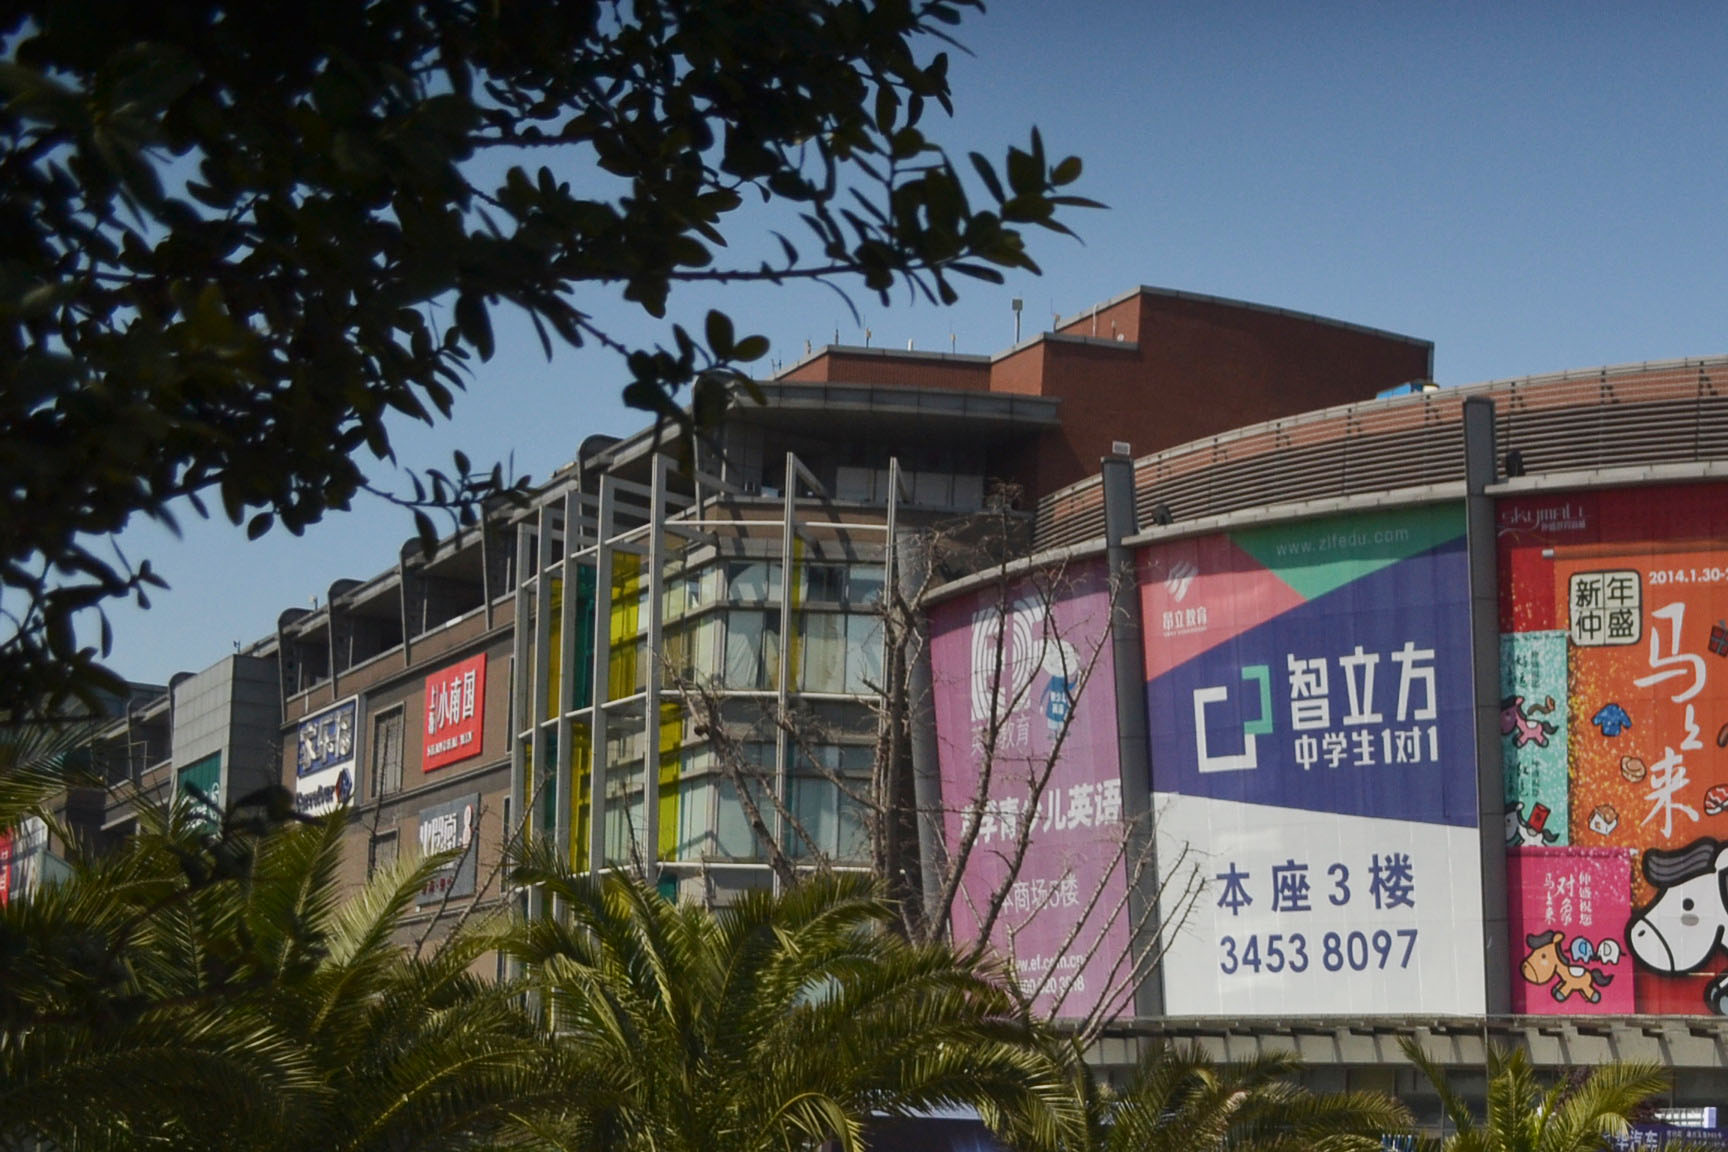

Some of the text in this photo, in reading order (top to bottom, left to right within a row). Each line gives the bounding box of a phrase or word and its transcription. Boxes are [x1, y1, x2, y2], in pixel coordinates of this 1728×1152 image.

[1575, 576, 1634, 609] 新年
[1575, 609, 1634, 640] 仲盛
[1287, 641, 1437, 731] 智立方
[970, 715, 1030, 756] 英教育
[1633, 602, 1707, 839] 马上来
[1293, 725, 1439, 771] 中学生1对1
[1215, 852, 1417, 916] 本座3楼
[1219, 928, 1419, 975] 3453 8097
